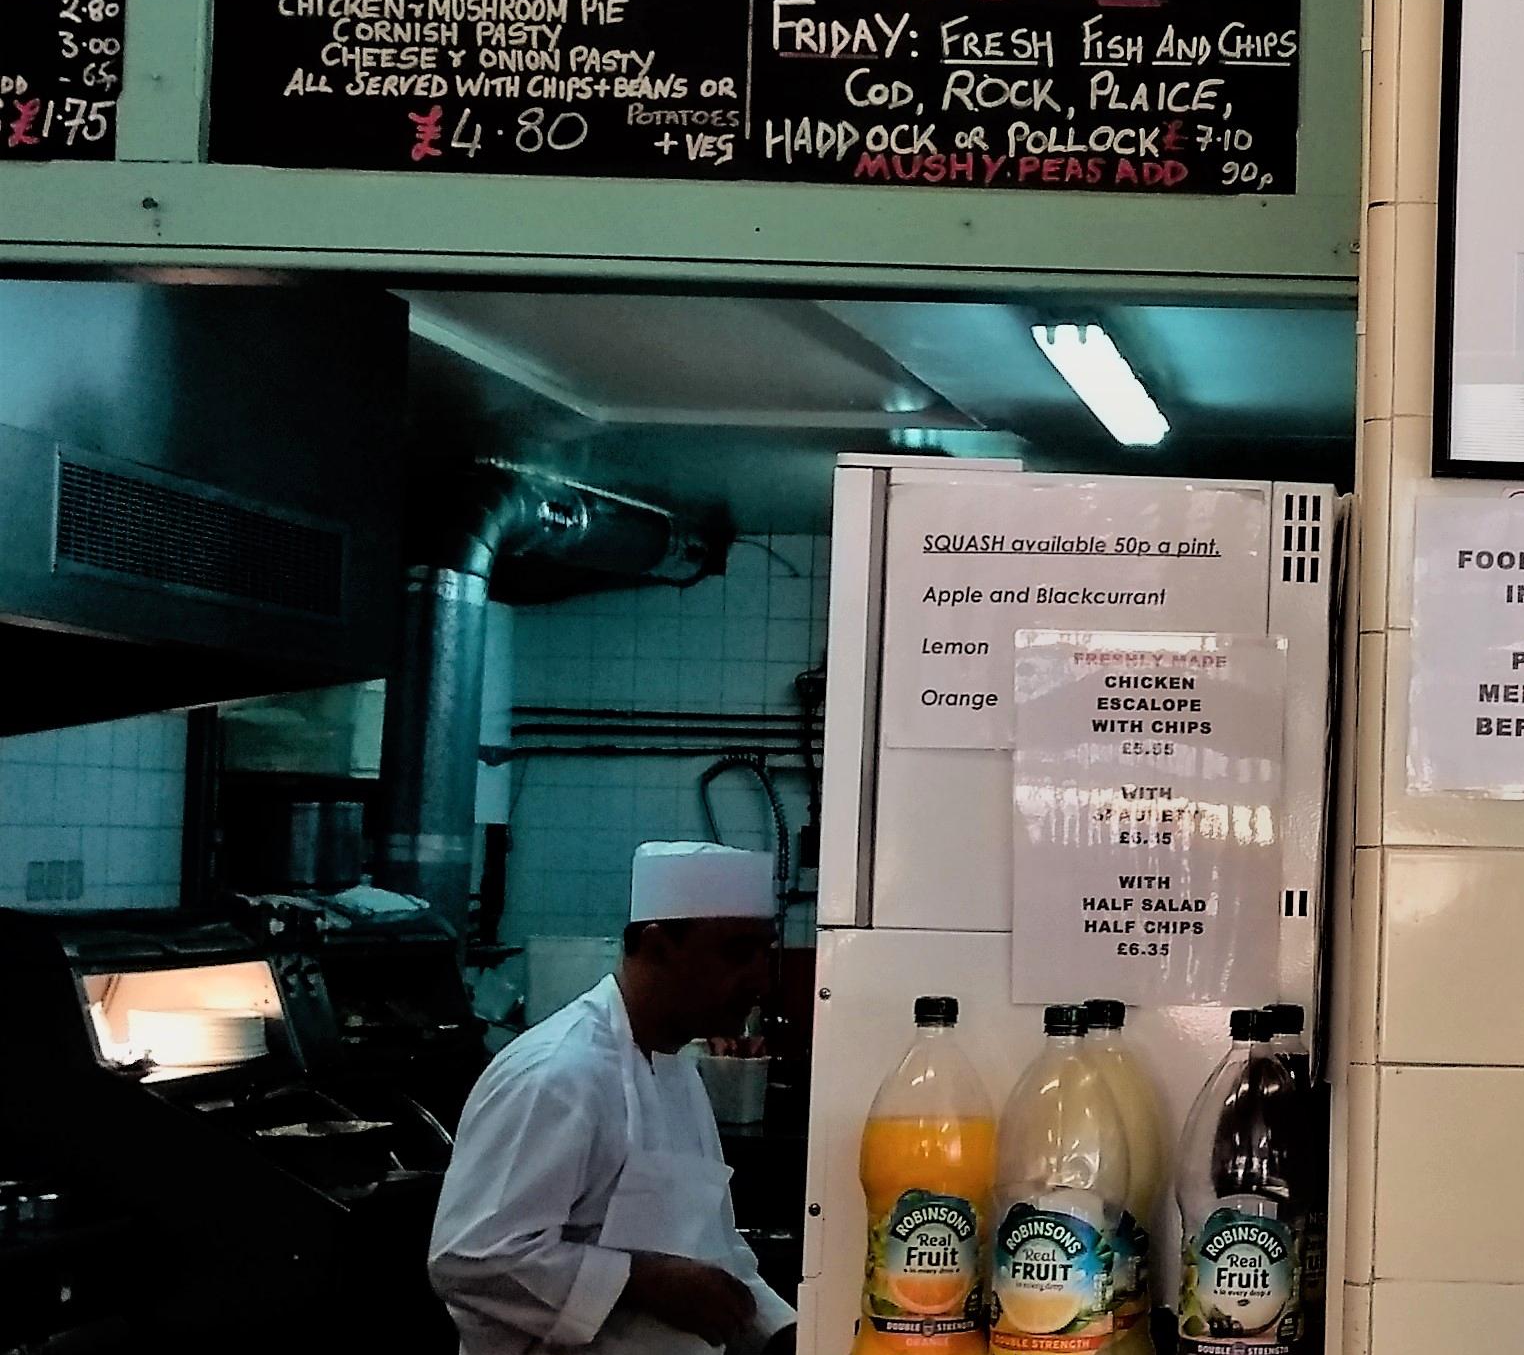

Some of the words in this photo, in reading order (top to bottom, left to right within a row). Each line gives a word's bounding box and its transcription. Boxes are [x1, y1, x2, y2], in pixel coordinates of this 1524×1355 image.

[58, 30, 121, 59] 3.00
[331, 19, 459, 46] CORNISH
[475, 20, 563, 50] PASTY
[940, 15, 1055, 69] FRESH
[1080, 12, 1146, 63] FISH
[1155, 23, 1213, 65] AND
[1217, 20, 1299, 61] CHIPS
[320, 45, 438, 73] CHEESE
[478, 47, 562, 73] ONION
[570, 47, 656, 78] PASTY
[282, 68, 334, 98] ALL
[345, 71, 448, 98] SERVED
[455, 76, 521, 100] WITH
[700, 77, 738, 100] OR
[843, 66, 924, 117] COD,
[940, 70, 1076, 122] ROCK,
[1089, 74, 1234, 122] PLAICE,
[627, 103, 741, 129] POTATOES
[685, 134, 735, 165] VEG
[764, 118, 938, 164] HADDOCK
[1007, 121, 1160, 159] POLLOCK
[1017, 157, 1104, 185] PEAS
[1113, 158, 1190, 186] ADD
[1220, 160, 1275, 190] 90p
[923, 534, 1005, 554] SQUASH
[1011, 535, 1106, 553] available
[1115, 537, 1151, 557] 50p
[1177, 537, 1222, 558] pint.
[922, 587, 984, 608] Apple
[989, 587, 1030, 605] and
[1036, 587, 1168, 606] Blackcurrant
[922, 637, 990, 656] Lemon
[1104, 675, 1195, 690] CHICKEN
[921, 689, 999, 712] Orange
[1097, 697, 1203, 712] ESCALOPE
[1092, 719, 1144, 733] WITH
[1151, 720, 1213, 735] CHIPS
[1121, 786, 1173, 800] WITH
[1119, 875, 1171, 889] WITH
[1083, 898, 1134, 911] HALF
[1141, 898, 1208, 913] SALAD
[1084, 920, 1136, 934] HALF
[1144, 920, 1205, 935] CHIPS
[1117, 942, 1171, 957] £6.35
[895, 1206, 972, 1238] ROBINSONS
[917, 1232, 952, 1247] Real
[1006, 1221, 1082, 1255] ROBINSONS
[1205, 1226, 1284, 1259] ROBINSONS
[905, 1246, 960, 1267] Fruit
[1022, 1247, 1057, 1262] Real
[1227, 1253, 1262, 1269] Real
[1011, 1262, 1073, 1282] FRUIT
[1216, 1267, 1270, 1290] Fruit
[1031, 1338, 1091, 1350] STRENGTH
